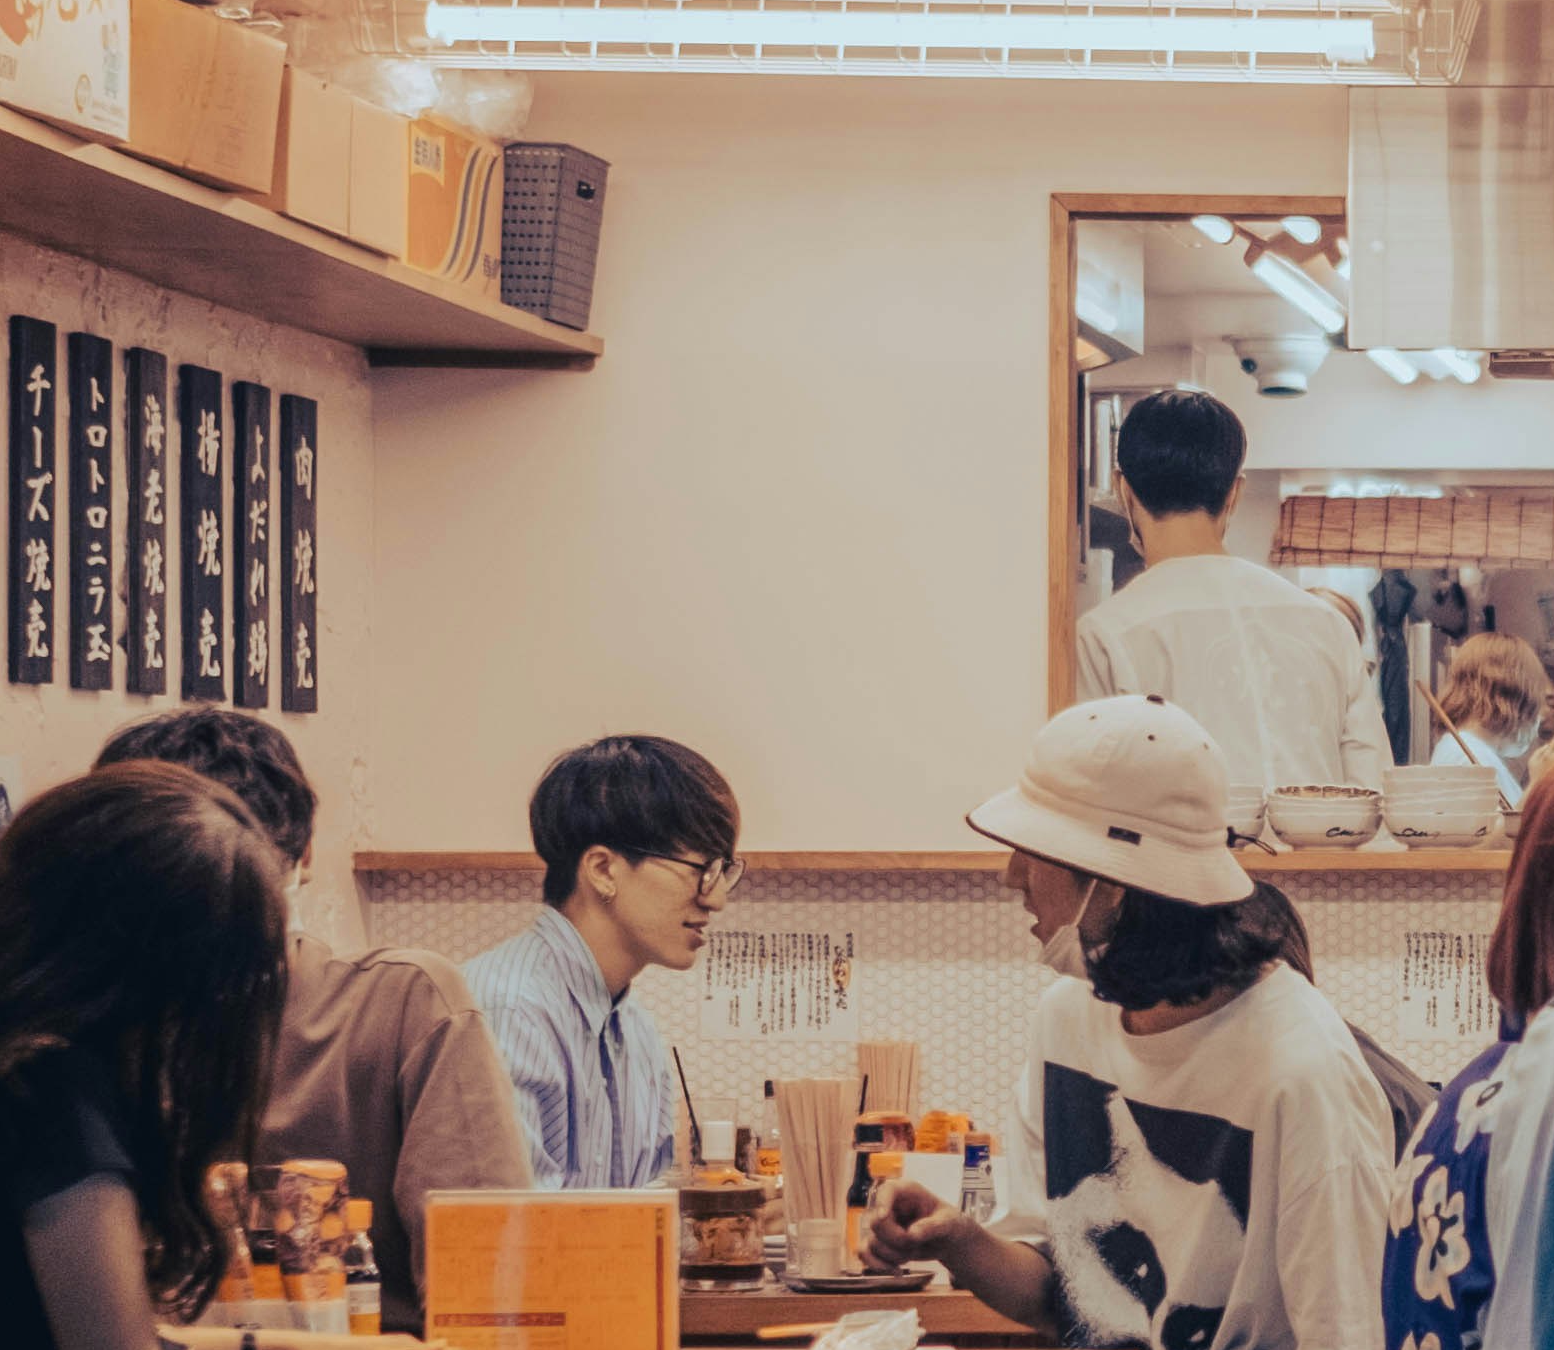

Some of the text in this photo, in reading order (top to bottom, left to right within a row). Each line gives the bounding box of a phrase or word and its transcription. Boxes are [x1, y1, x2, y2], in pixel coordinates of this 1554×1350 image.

[26, 364, 52, 658] チーズ焼売
[86, 377, 110, 662] トロトロニラ玉
[198, 409, 221, 677] 揚焼売
[295, 435, 315, 688] 肉焼売
